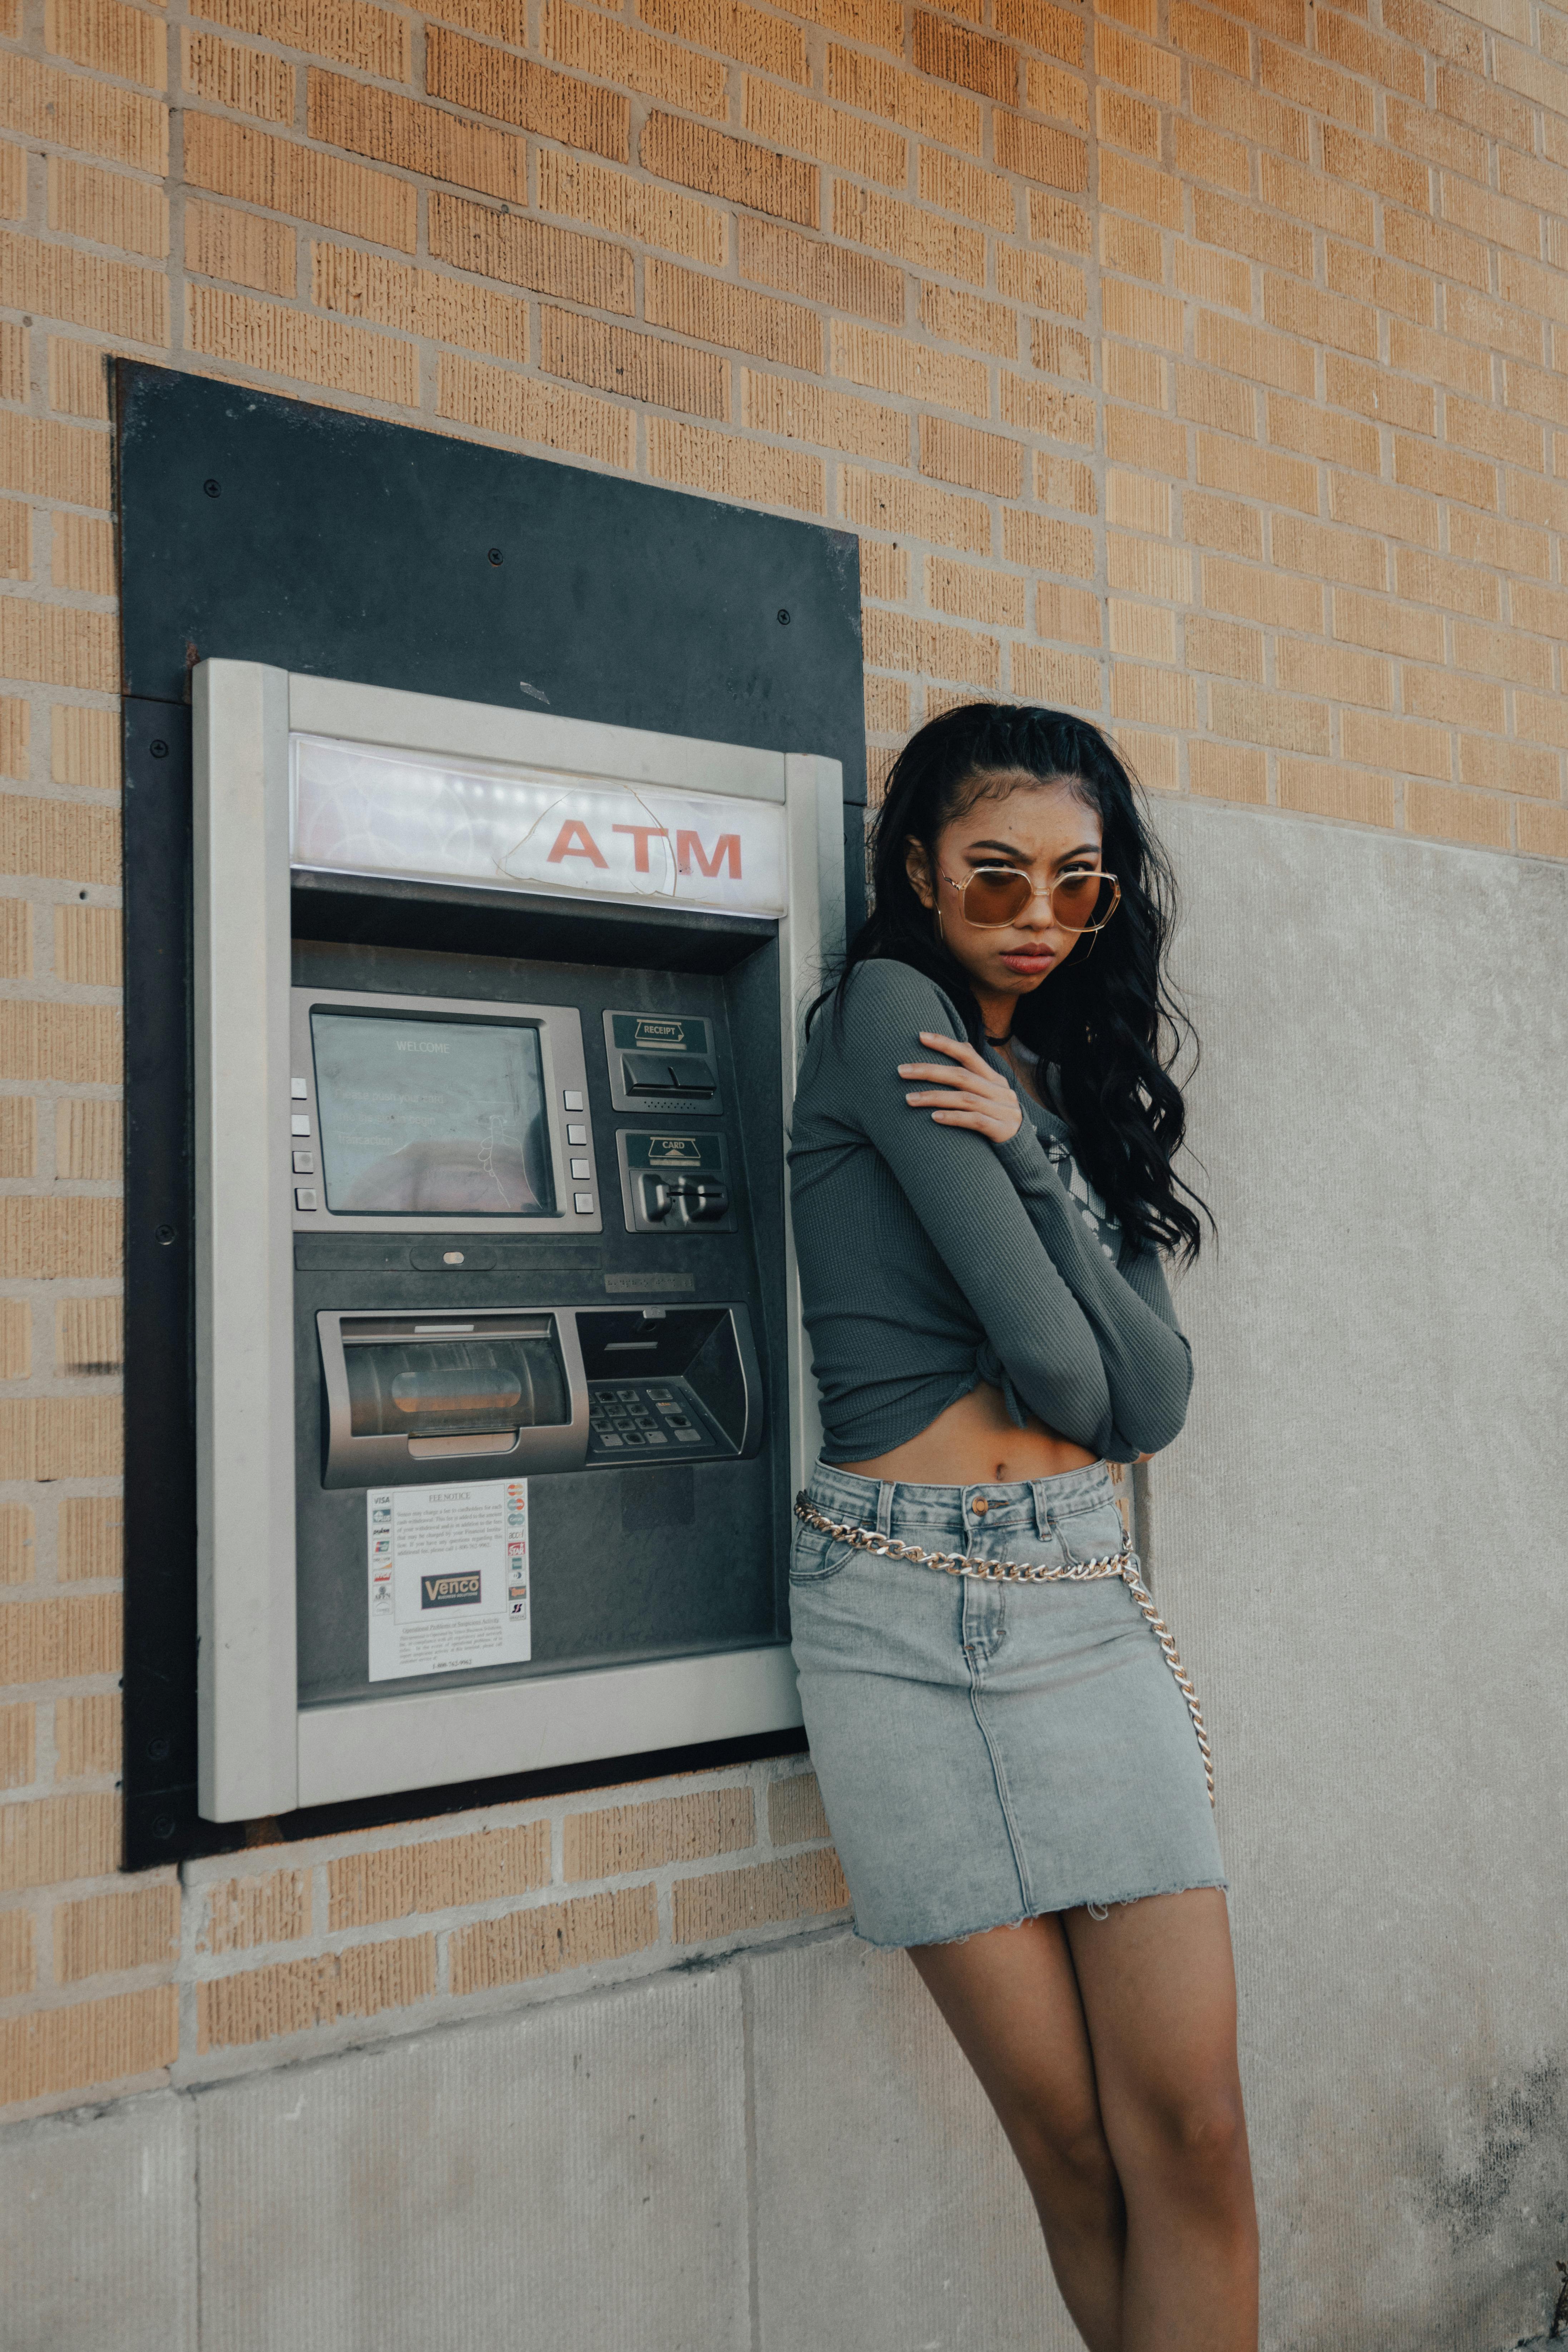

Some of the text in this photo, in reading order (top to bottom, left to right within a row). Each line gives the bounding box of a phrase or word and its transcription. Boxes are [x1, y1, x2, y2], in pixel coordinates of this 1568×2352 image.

[546, 819, 742, 880] ATM
[644, 1026, 675, 1035] RECEIPT
[396, 1041, 450, 1054] WELCOME
[337, 1135, 393, 1145] transaction
[444, 1492, 471, 1501] NOTICE
[509, 1529, 524, 1540] accel
[425, 1576, 479, 1601] Venco
[402, 1625, 429, 1634] Operational
[457, 1620, 482, 1629] Suspicious
[432, 1659, 472, 1670] 1-800-762-9962
